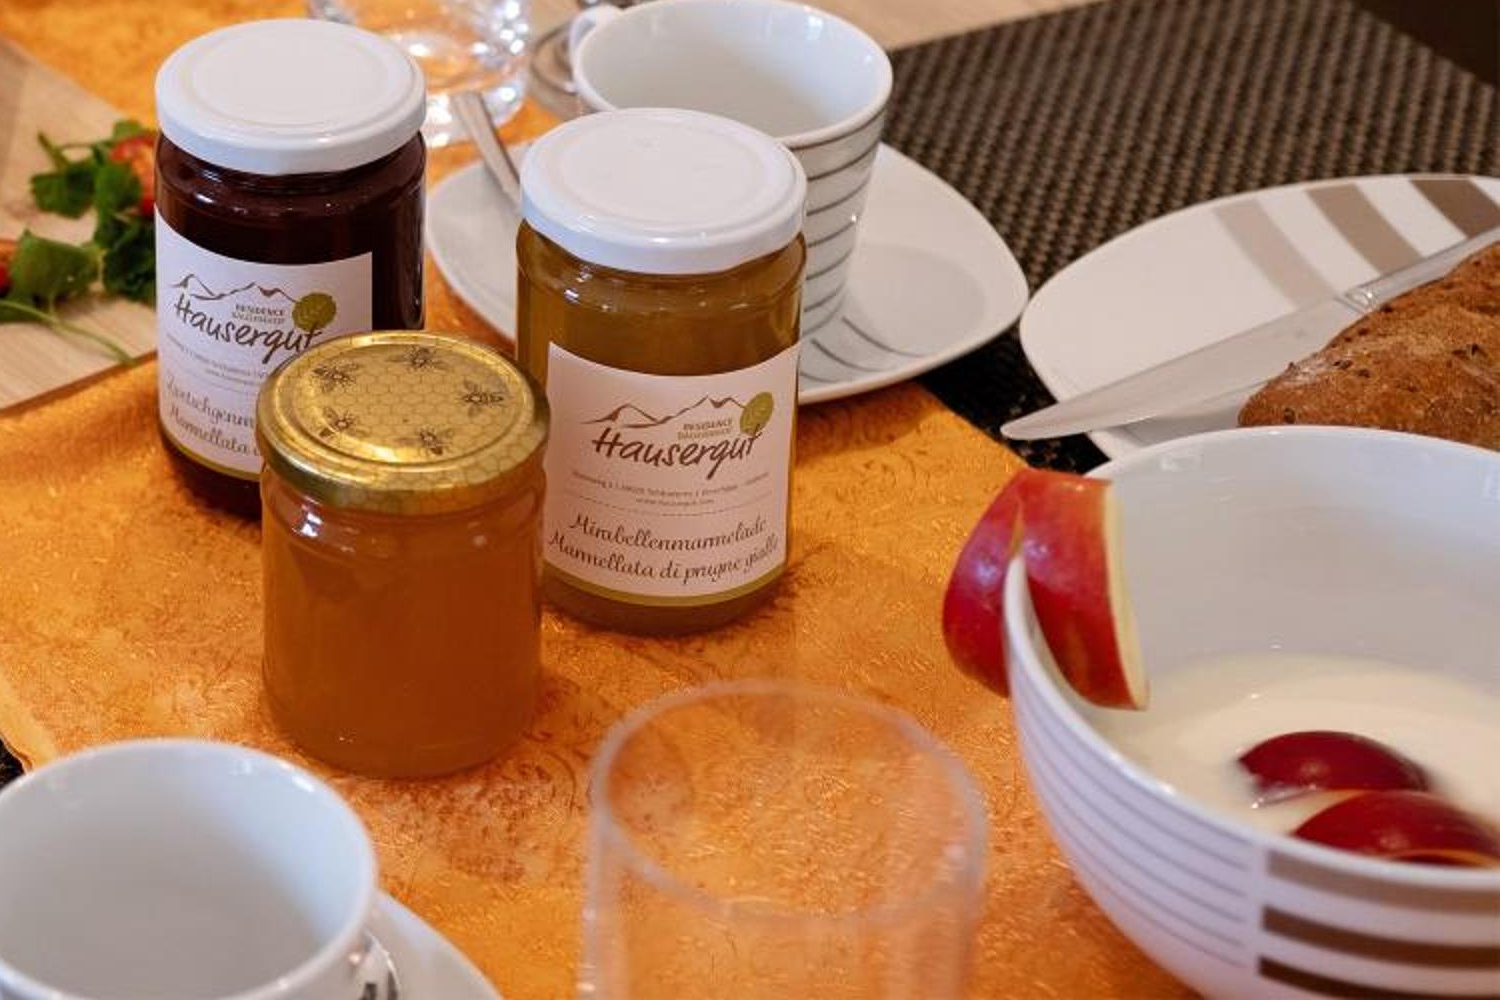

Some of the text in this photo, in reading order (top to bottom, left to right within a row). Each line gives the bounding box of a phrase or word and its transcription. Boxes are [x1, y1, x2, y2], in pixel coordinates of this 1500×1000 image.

[174, 294, 323, 364] Hausergut
[591, 424, 763, 480] Hausergut
[659, 560, 683, 579] di
